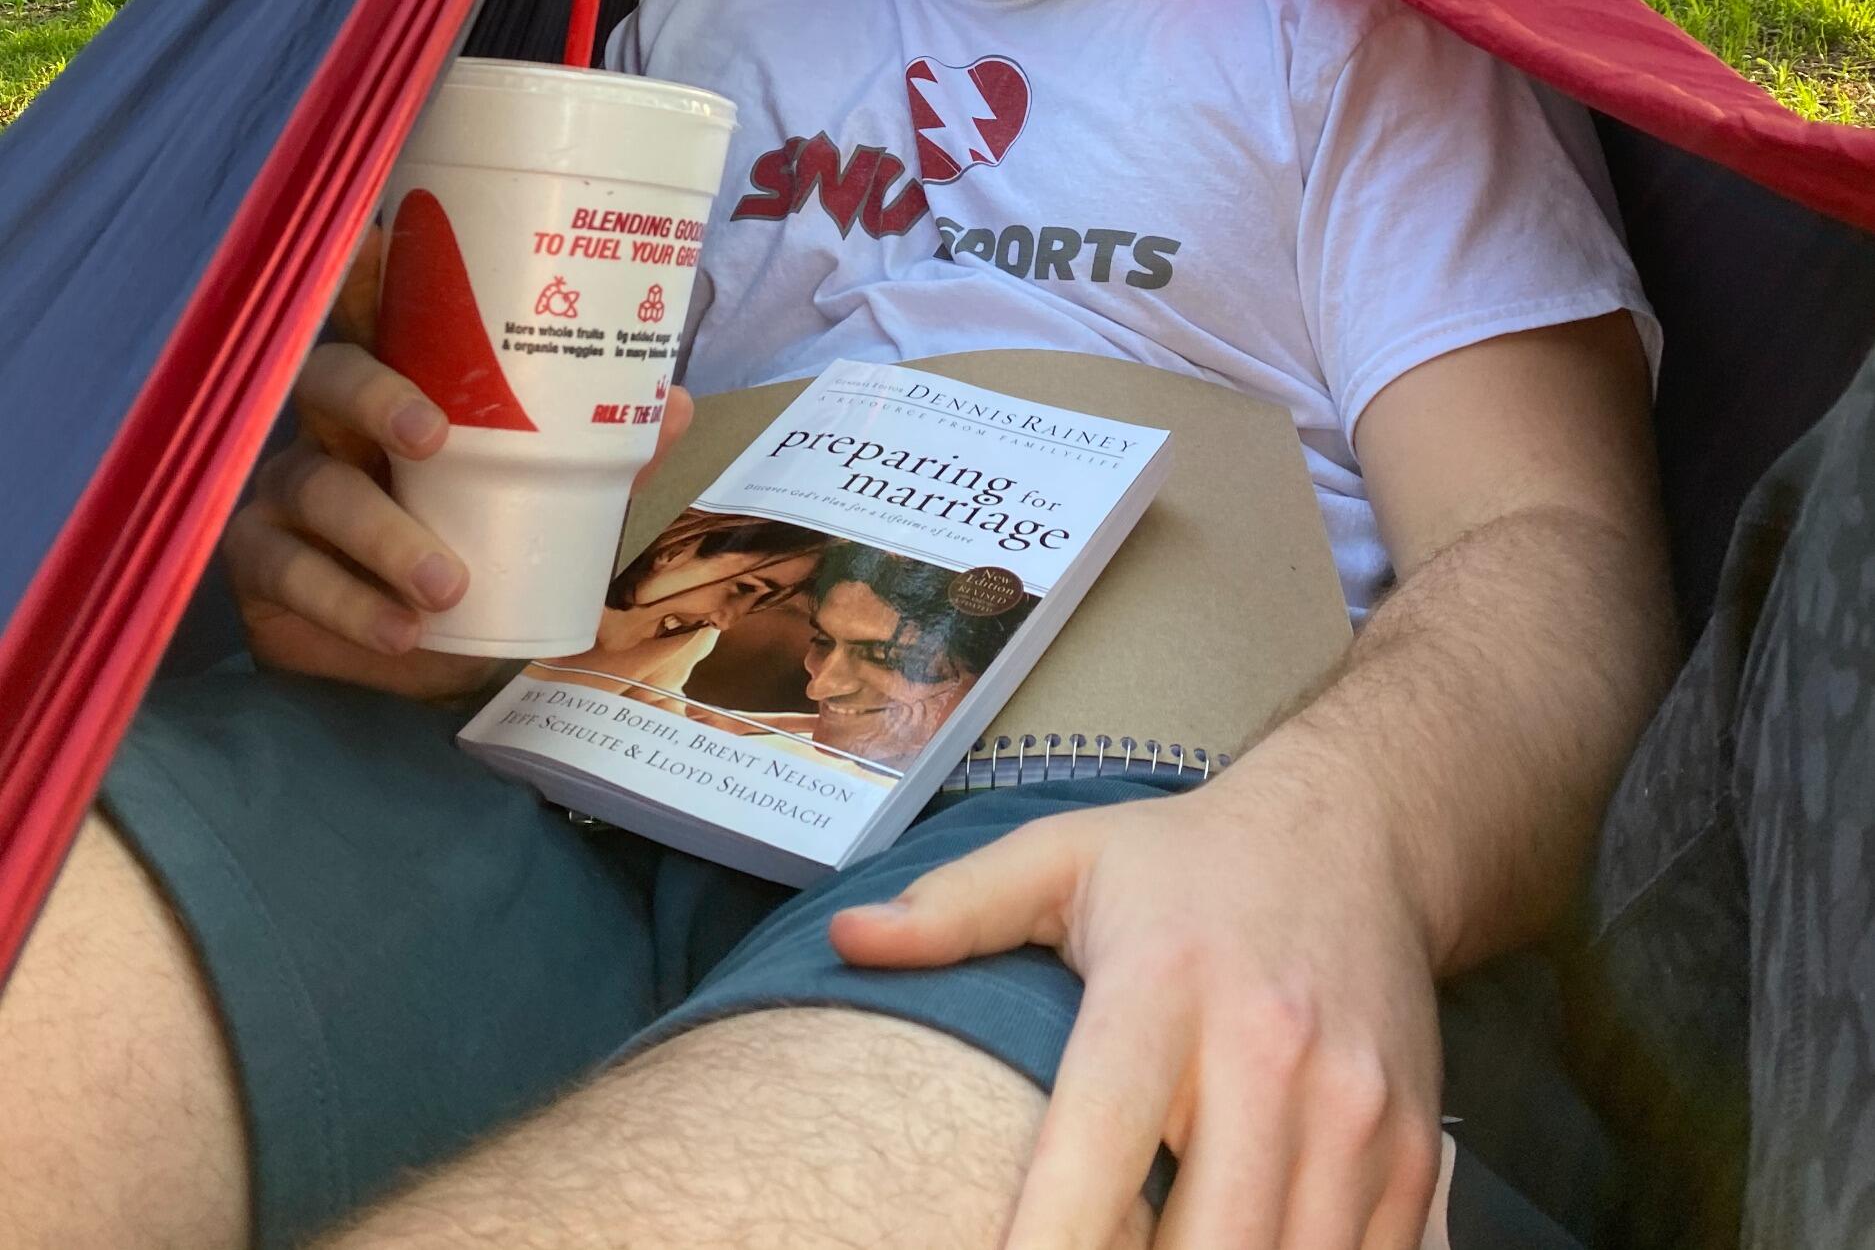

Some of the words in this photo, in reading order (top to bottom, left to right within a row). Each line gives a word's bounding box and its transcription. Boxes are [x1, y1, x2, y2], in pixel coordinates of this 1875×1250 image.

[571, 208, 673, 238] BLENDING
[533, 232, 565, 256] TO
[568, 235, 622, 261] FUEL
[631, 240, 675, 265] YOUR
[502, 338, 511, 351] &
[514, 340, 559, 355] organic
[562, 344, 605, 359] veggies
[504, 322, 535, 336] More
[539, 326, 574, 338] whole
[576, 327, 605, 341] fruits
[591, 403, 631, 425] RULE
[837, 397, 928, 419] RESOURCE
[937, 418, 987, 437] FROM
[905, 384, 1017, 425] DENNIS
[1020, 415, 1138, 453] RAINEY
[768, 430, 1017, 506] preparing
[1019, 490, 1063, 511] for
[744, 483, 789, 494] Discover
[790, 489, 819, 500] God's
[821, 495, 846, 508] Plan
[879, 511, 927, 530] Lifetime
[946, 530, 975, 544] Love
[837, 473, 1070, 551] marriage
[965, 573, 1015, 596] Edition
[981, 568, 1010, 585] New
[520, 690, 544, 702] BY
[547, 690, 609, 716] DAVID
[613, 707, 680, 746] BOEHI,
[688, 734, 760, 769] BRENT
[763, 759, 855, 803] NELSON
[499, 710, 541, 725] JEFF
[538, 715, 624, 752] SCHULTE
[624, 743, 643, 760] &
[645, 750, 713, 786] LLOYD
[716, 775, 833, 829] SHADRACH
